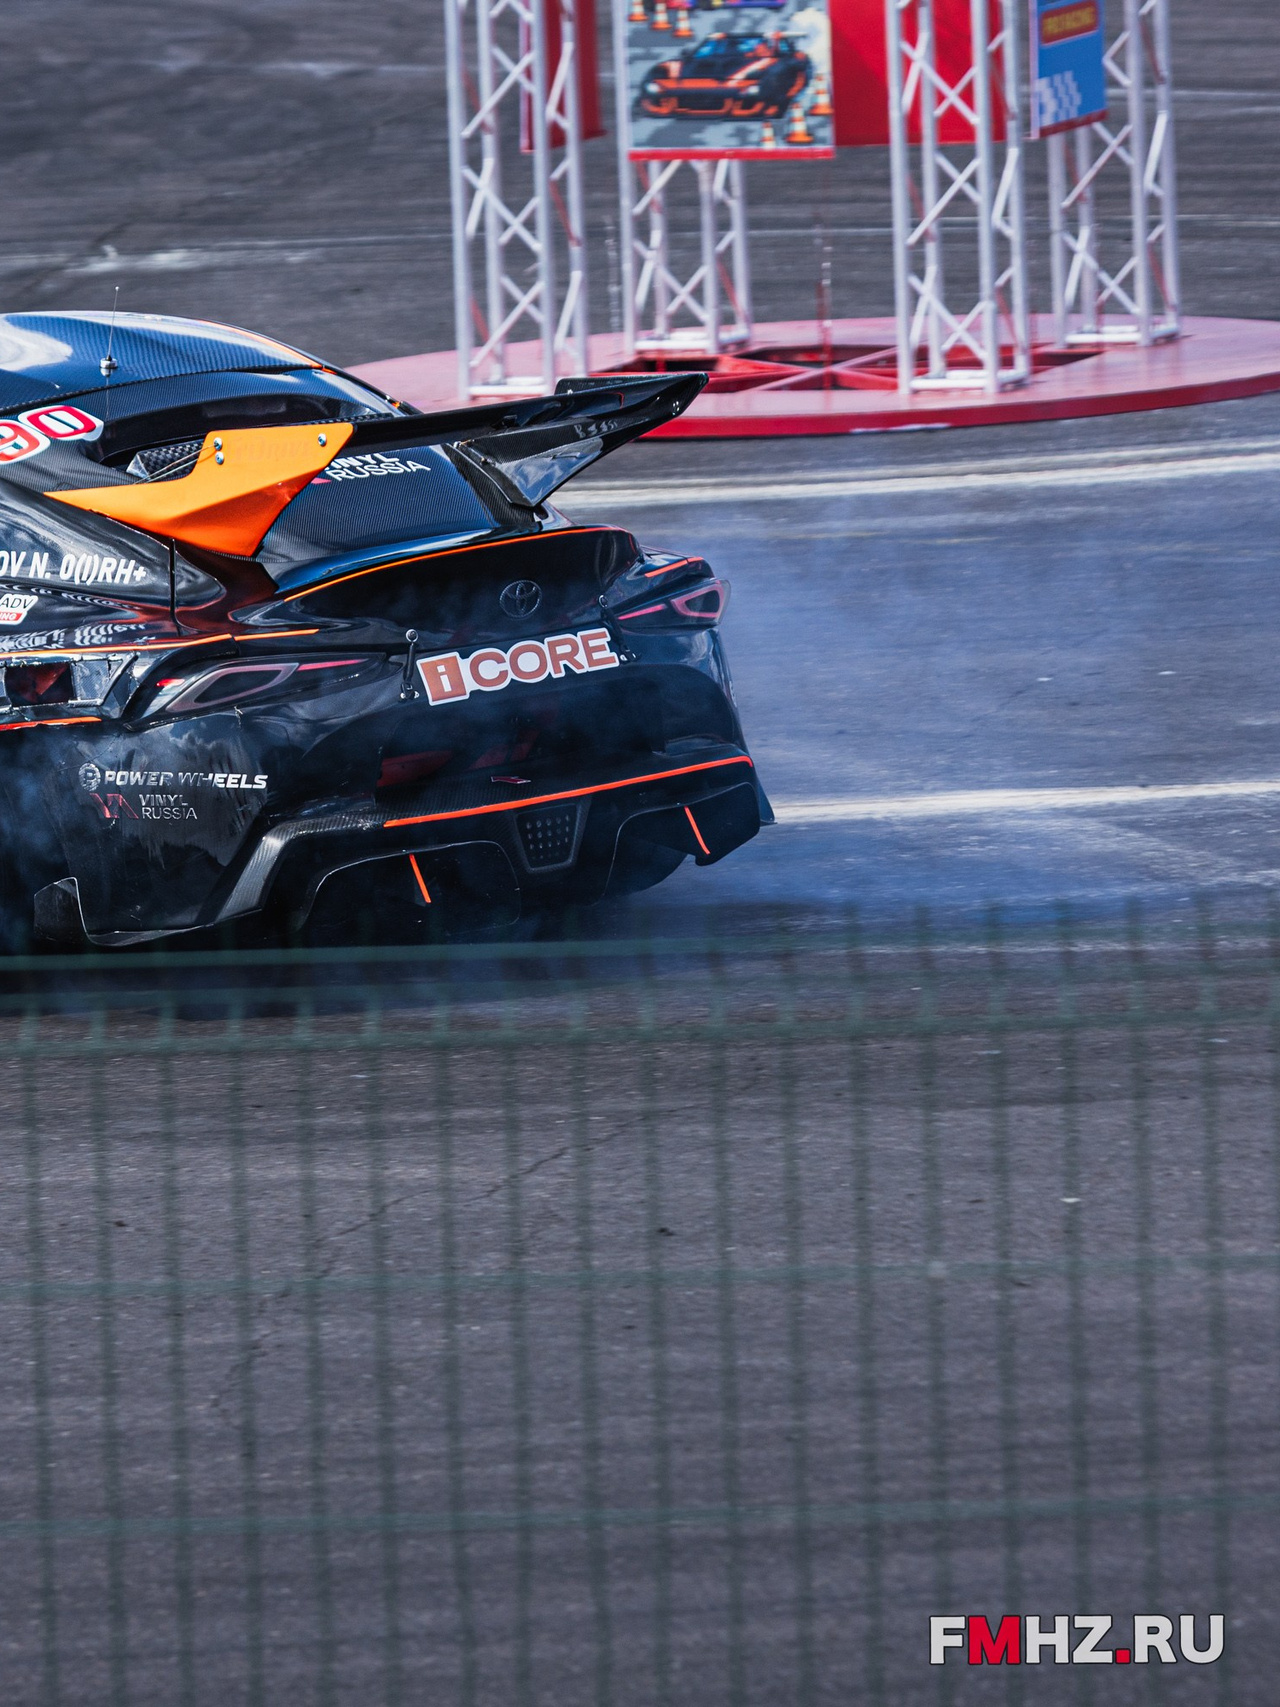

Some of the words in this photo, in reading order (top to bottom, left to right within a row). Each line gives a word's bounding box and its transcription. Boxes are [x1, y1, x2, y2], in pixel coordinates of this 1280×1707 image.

[324, 453, 400, 471] INYL
[325, 460, 431, 481] RUSSIA
[28, 551, 51, 579] N.
[0, 597, 35, 609] ADV
[104, 770, 173, 787] POWER
[178, 772, 269, 789] WHEELS
[138, 794, 189, 807] VINYL
[142, 807, 198, 820] RUSSIA
